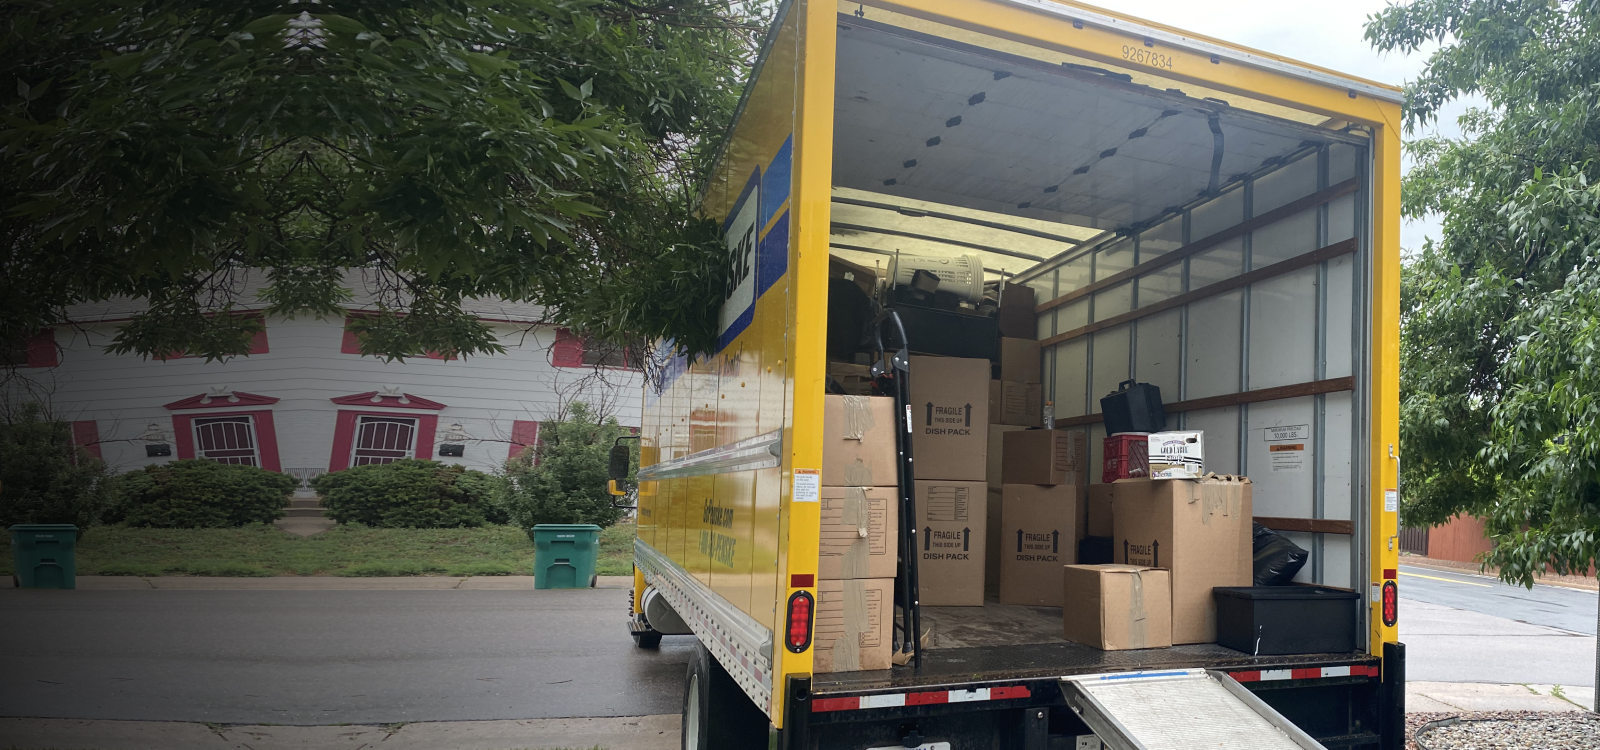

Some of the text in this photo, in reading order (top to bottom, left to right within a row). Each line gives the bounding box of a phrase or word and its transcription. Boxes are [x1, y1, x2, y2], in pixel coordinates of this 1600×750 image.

[1122, 45, 1172, 70] 9267834
[724, 221, 755, 303] SKE
[935, 406, 963, 416] FRAGILE
[947, 428, 971, 436] PACK
[934, 531, 961, 540] FRAGILE
[1026, 533, 1051, 542] FRAGILE
[1130, 544, 1152, 555] FRAGILE
